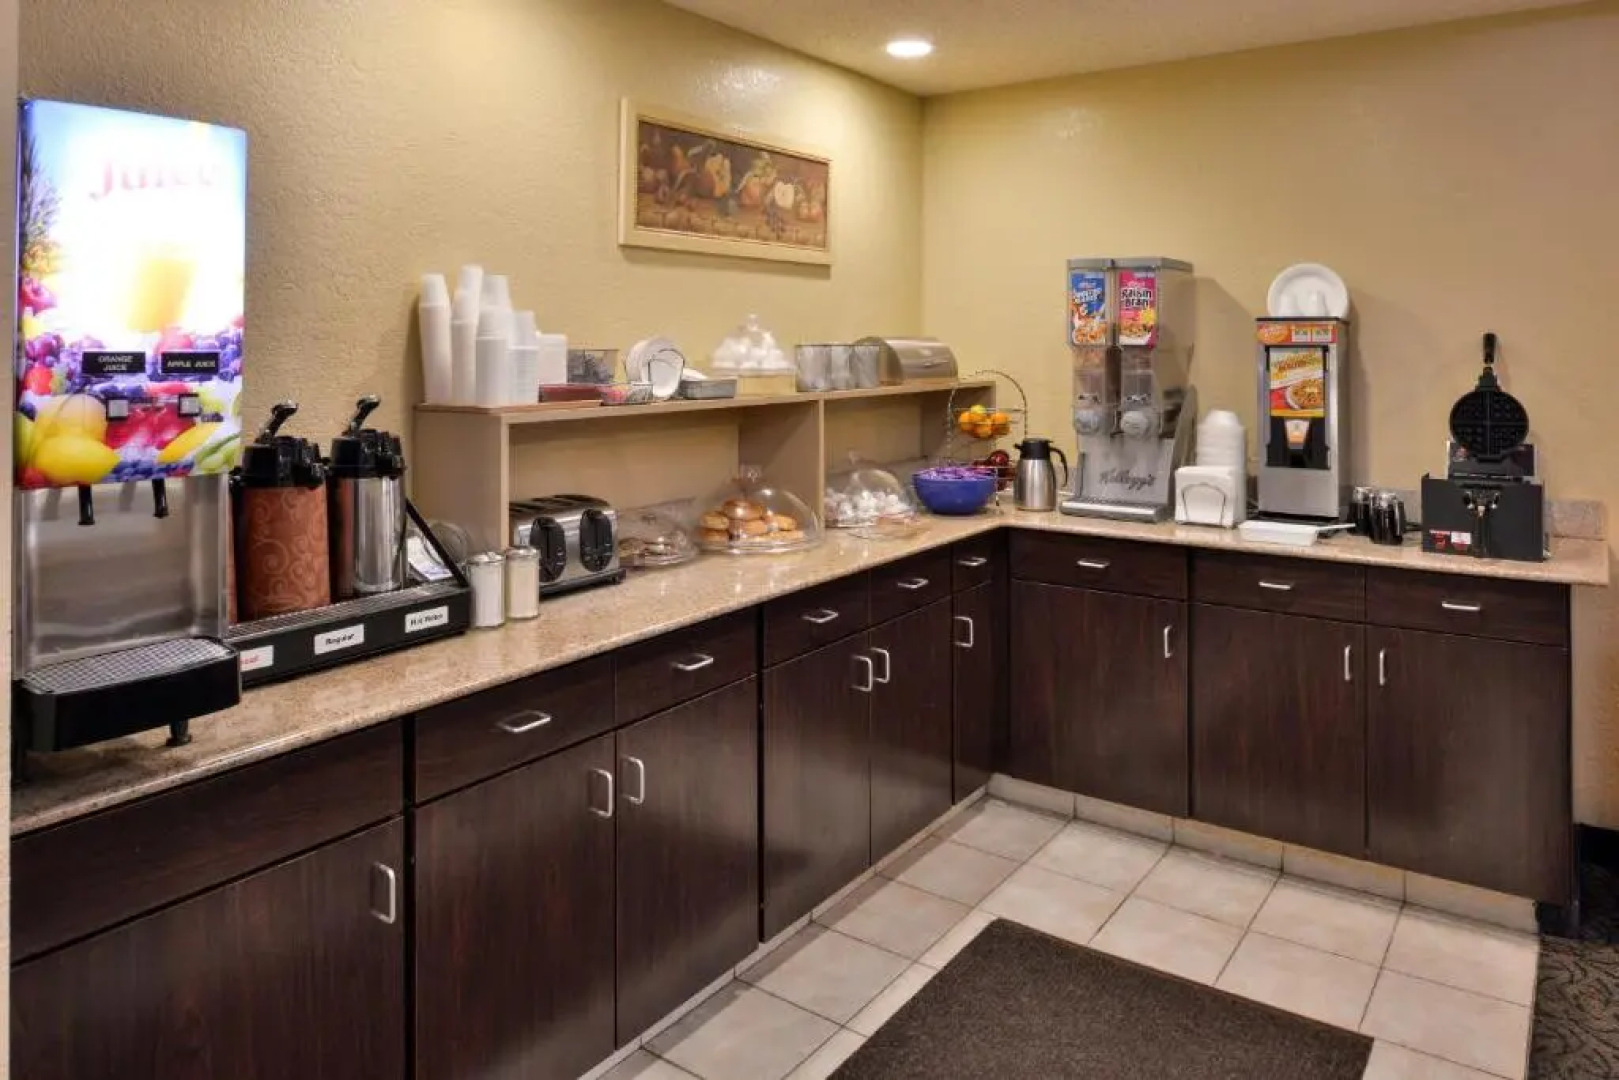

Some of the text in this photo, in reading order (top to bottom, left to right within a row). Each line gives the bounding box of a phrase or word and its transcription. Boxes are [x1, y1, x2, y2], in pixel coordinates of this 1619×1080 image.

[1121, 288, 1152, 299] Raisin
[98, 355, 134, 364] ORANGE
[167, 360, 216, 368] APPLE JUICE
[103, 363, 128, 371] JUICE
[325, 633, 355, 646] Regular
